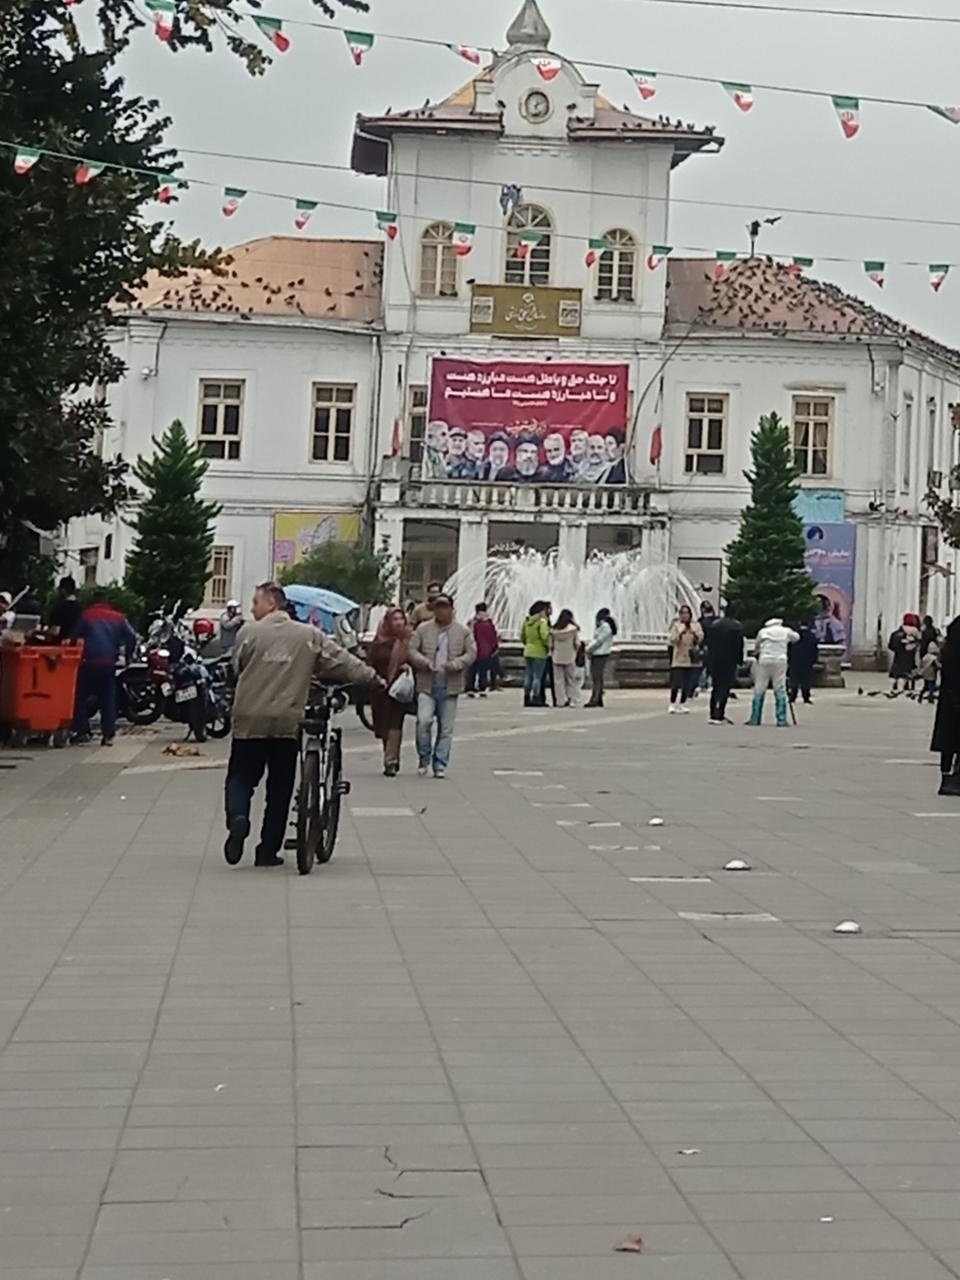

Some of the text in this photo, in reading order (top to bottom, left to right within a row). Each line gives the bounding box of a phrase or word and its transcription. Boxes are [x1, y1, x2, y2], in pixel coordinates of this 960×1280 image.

[446, 371, 477, 381] هست
[477, 371, 506, 384] مبارزه
[506, 374, 536, 383] هست
[536, 373, 560, 385] باطل
[567, 374, 584, 387] حق
[585, 373, 608, 386] جنگ
[608, 374, 617, 385] تا
[444, 386, 491, 399] هستیم
[491, 386, 511, 398] ما
[512, 389, 551, 399] هست
[551, 389, 592, 401] مبارزه
[592, 389, 609, 400] تا
